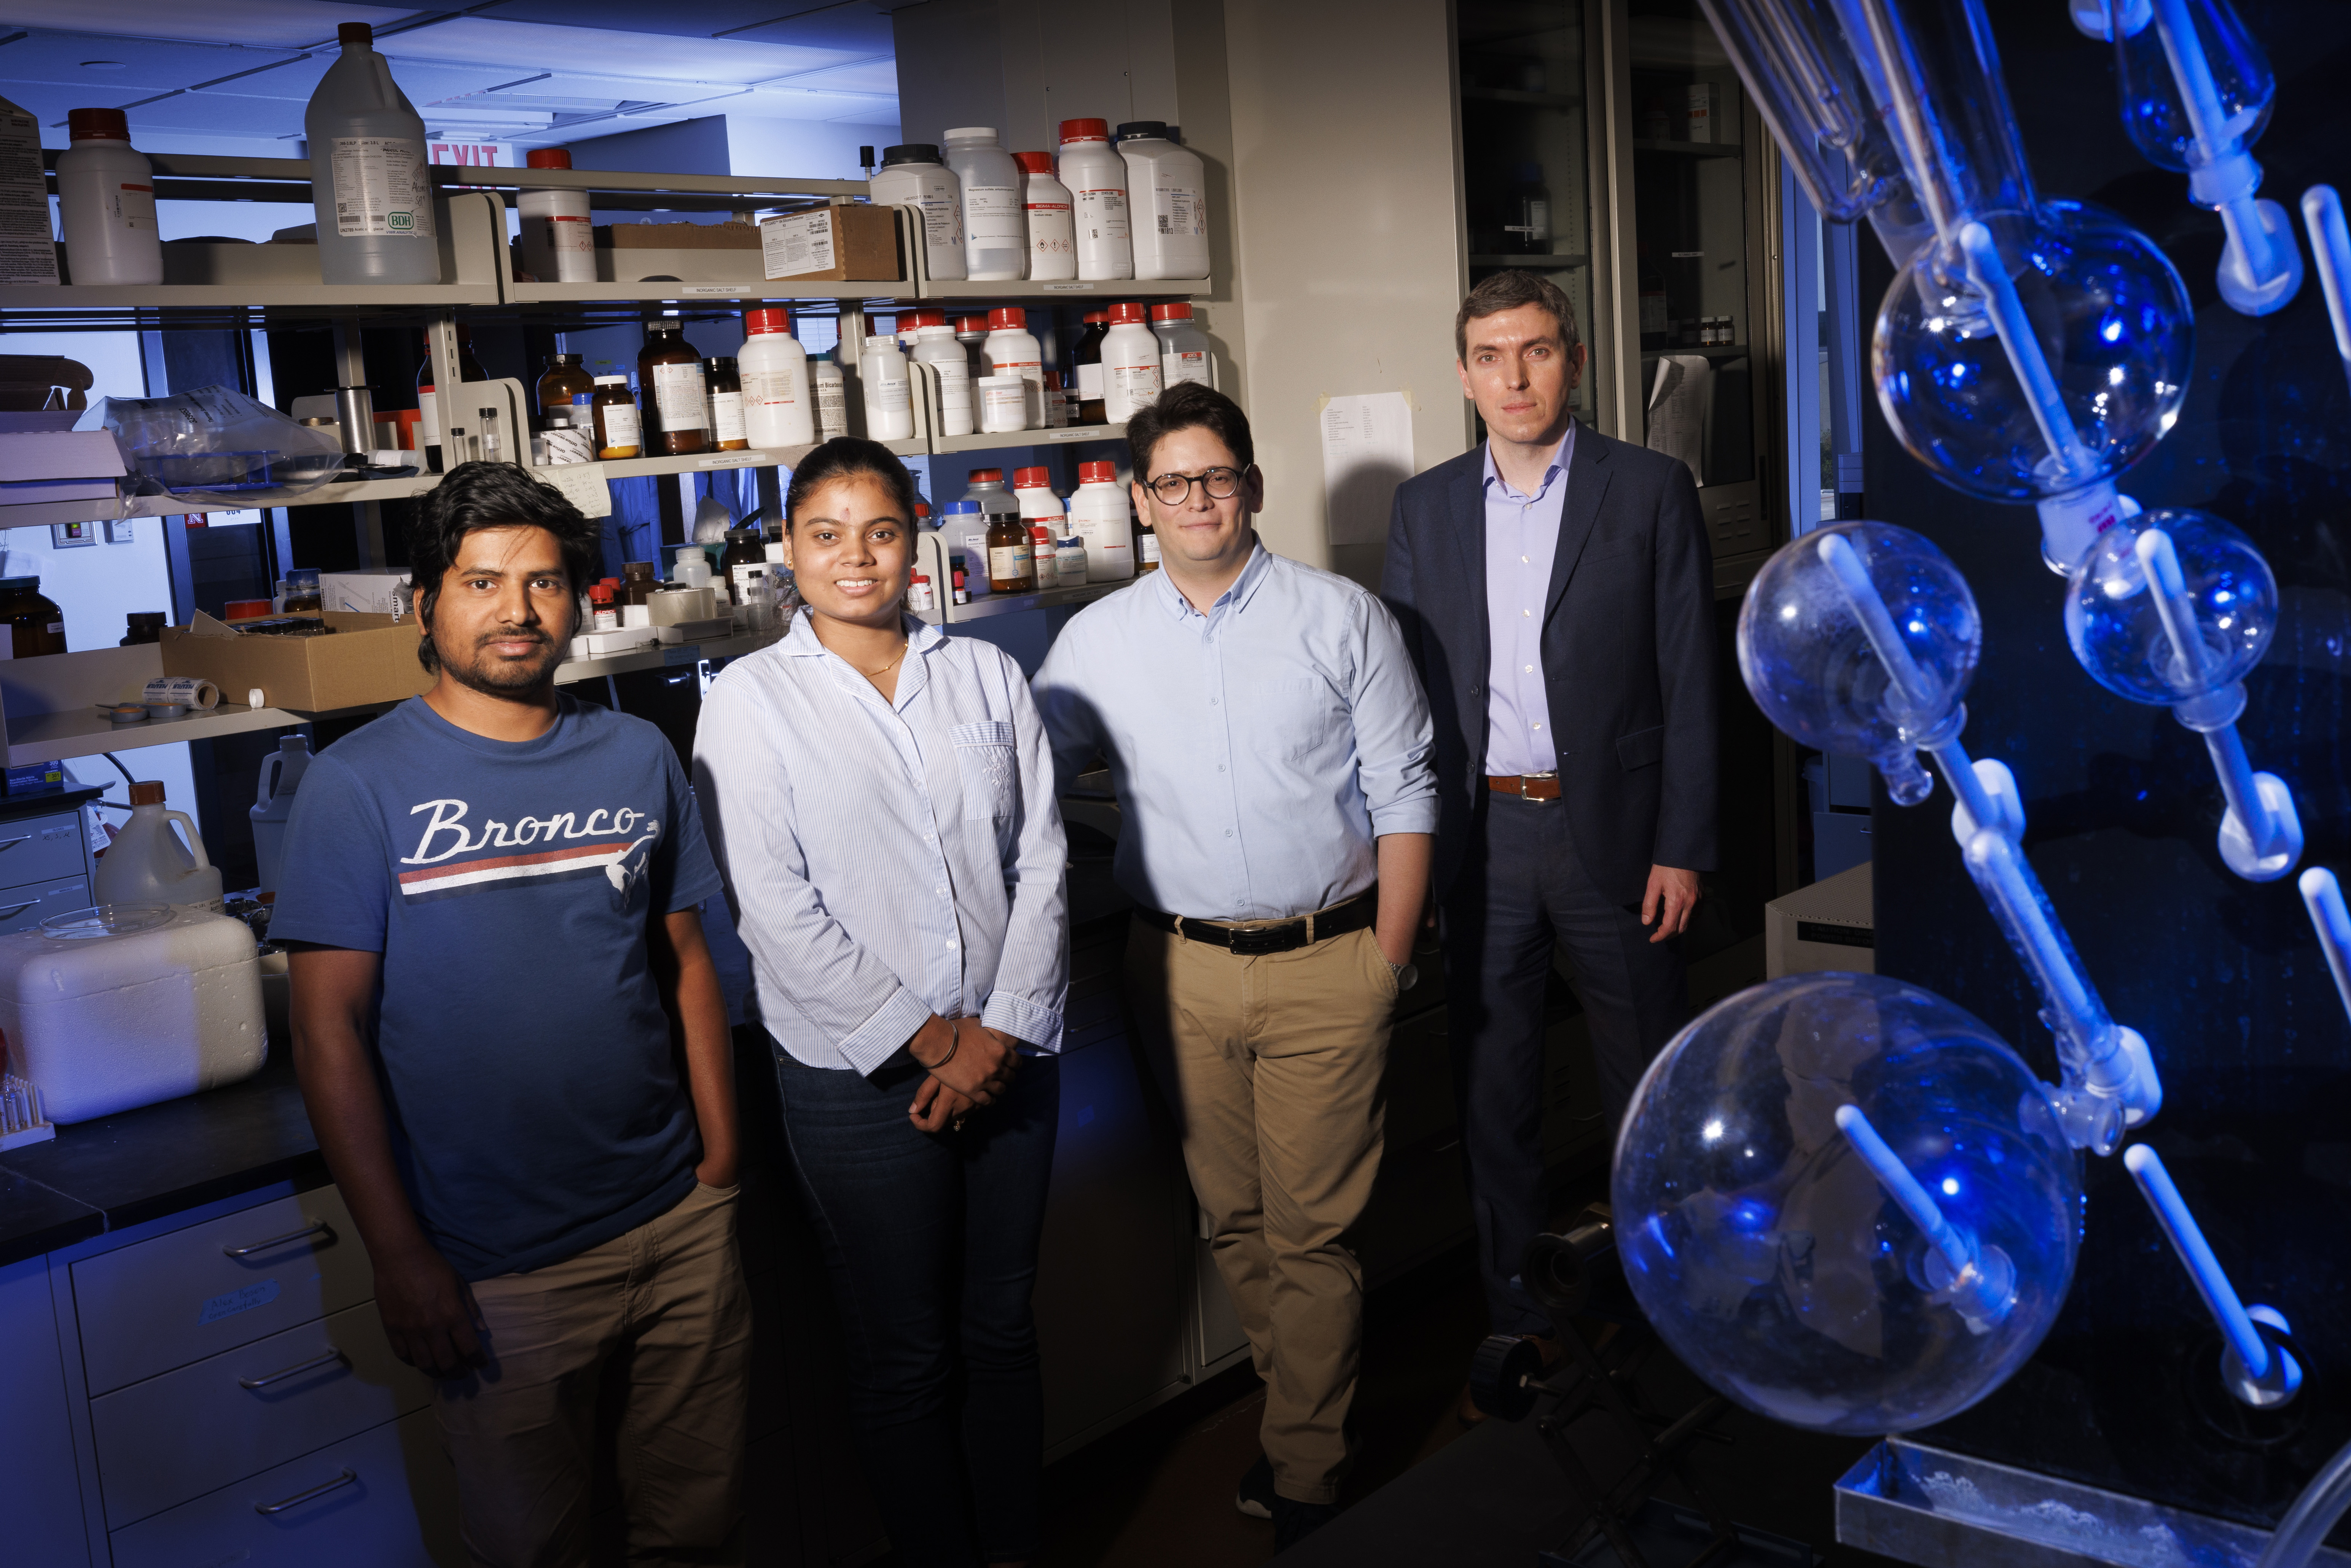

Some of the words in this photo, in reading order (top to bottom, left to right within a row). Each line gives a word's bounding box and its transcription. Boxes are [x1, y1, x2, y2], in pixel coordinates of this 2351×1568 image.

[392, 215, 411, 226] BDH
[179, 408, 198, 423] 339653
[577, 431, 586, 440] Office
[565, 438, 578, 447] Office
[553, 444, 565, 453] Office
[401, 799, 645, 864] Bronco
[1811, 933, 1842, 941] POWER
[209, 1310, 226, 1319] Open
[227, 1299, 260, 1312] Carefully
[212, 1298, 233, 1310] Alex
